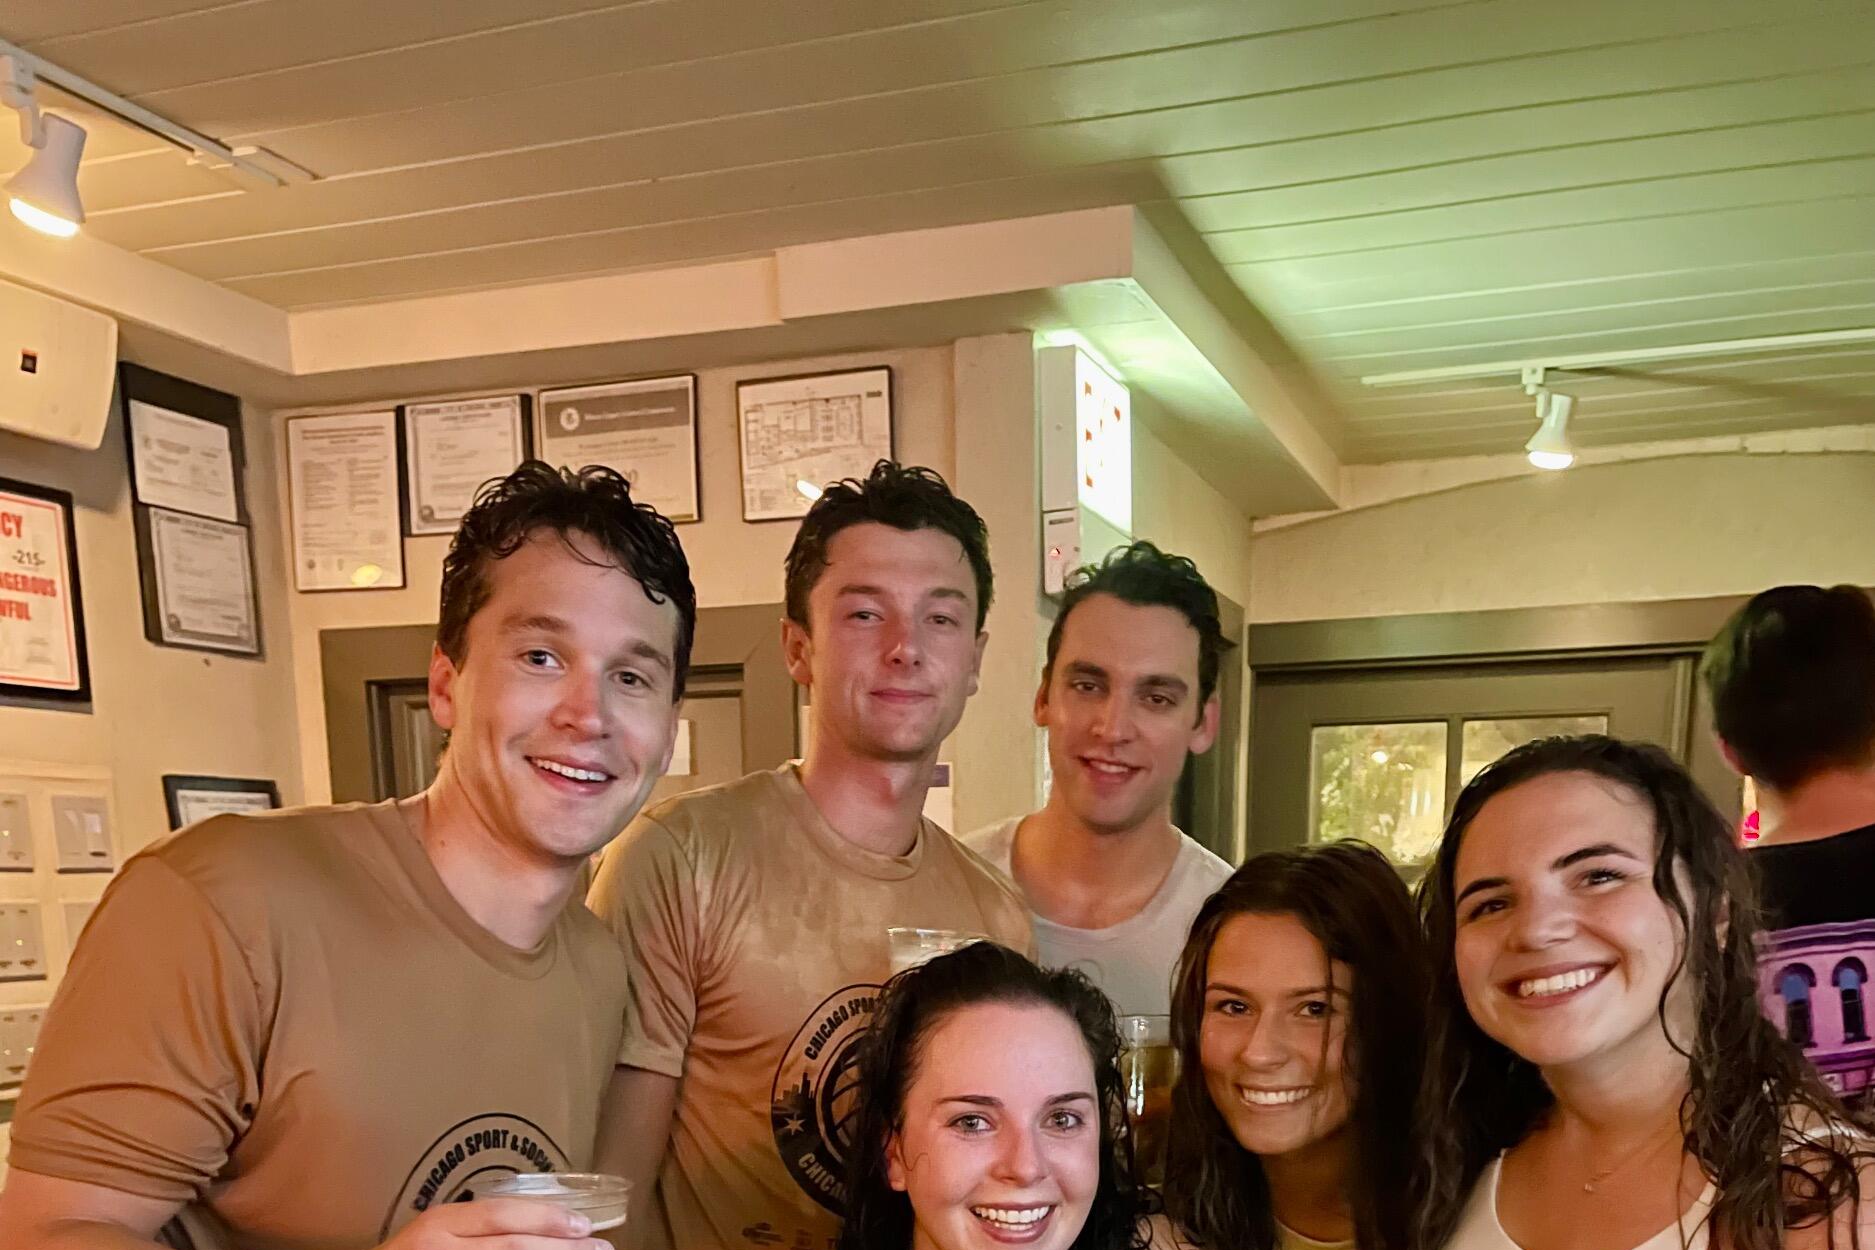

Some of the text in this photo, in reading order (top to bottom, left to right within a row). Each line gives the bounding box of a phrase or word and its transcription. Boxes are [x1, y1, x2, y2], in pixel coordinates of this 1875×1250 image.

[804, 1005, 849, 1060] CHICAGO
[414, 1143, 465, 1212] CHICAGO
[465, 1129, 509, 1156] SPORT
[511, 1134, 520, 1152] &
